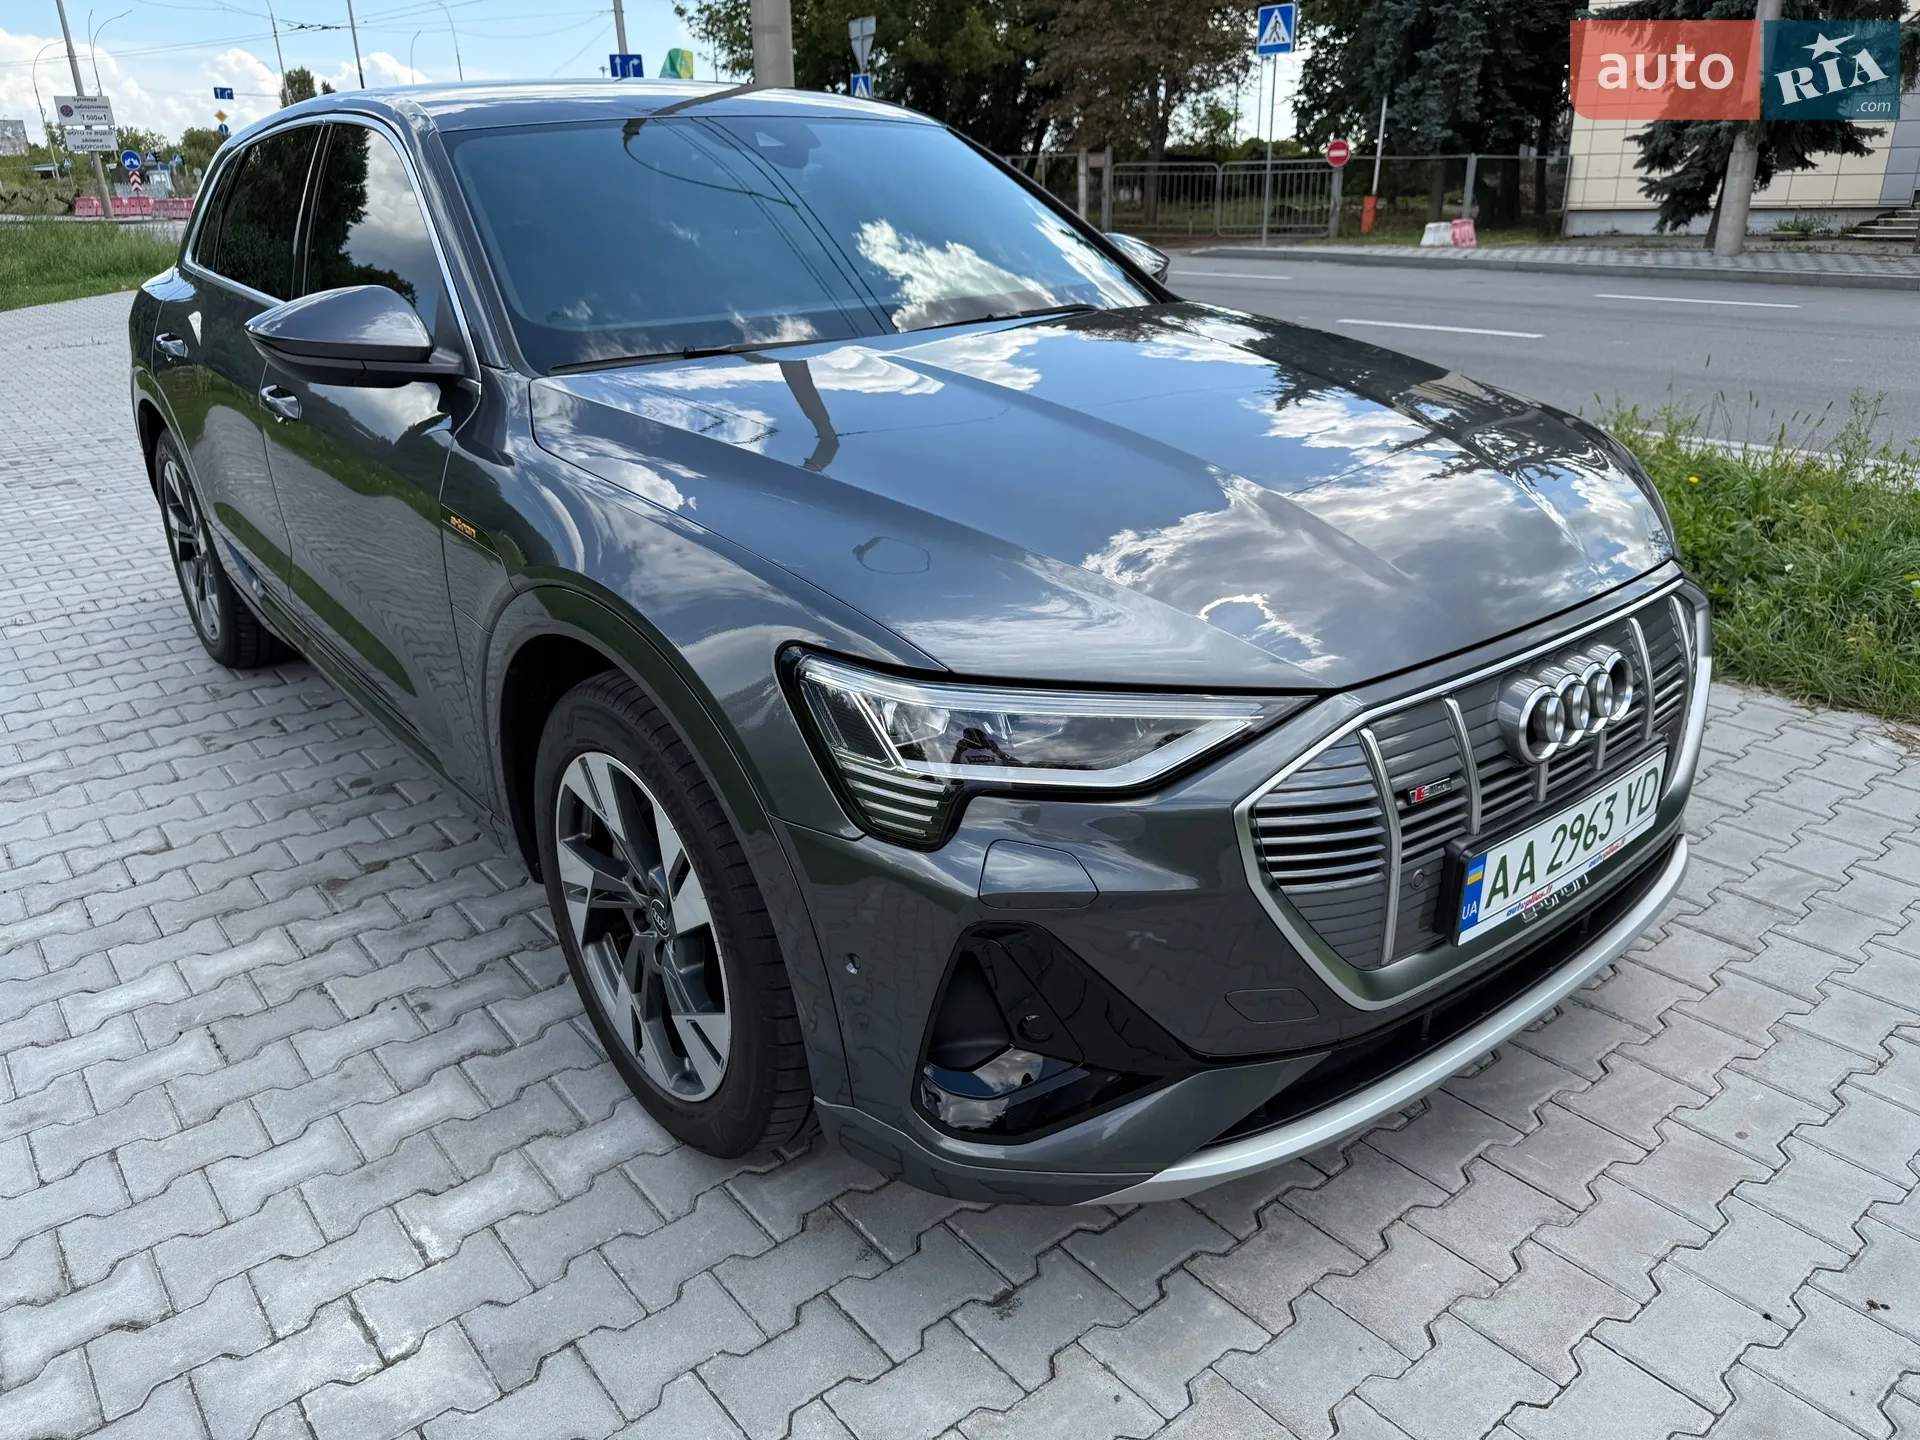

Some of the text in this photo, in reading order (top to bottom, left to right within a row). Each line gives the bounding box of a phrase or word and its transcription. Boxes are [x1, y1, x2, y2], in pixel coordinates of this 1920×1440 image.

[1484, 766, 1660, 909] AA 2963 YD
[1462, 904, 1478, 921] UA
